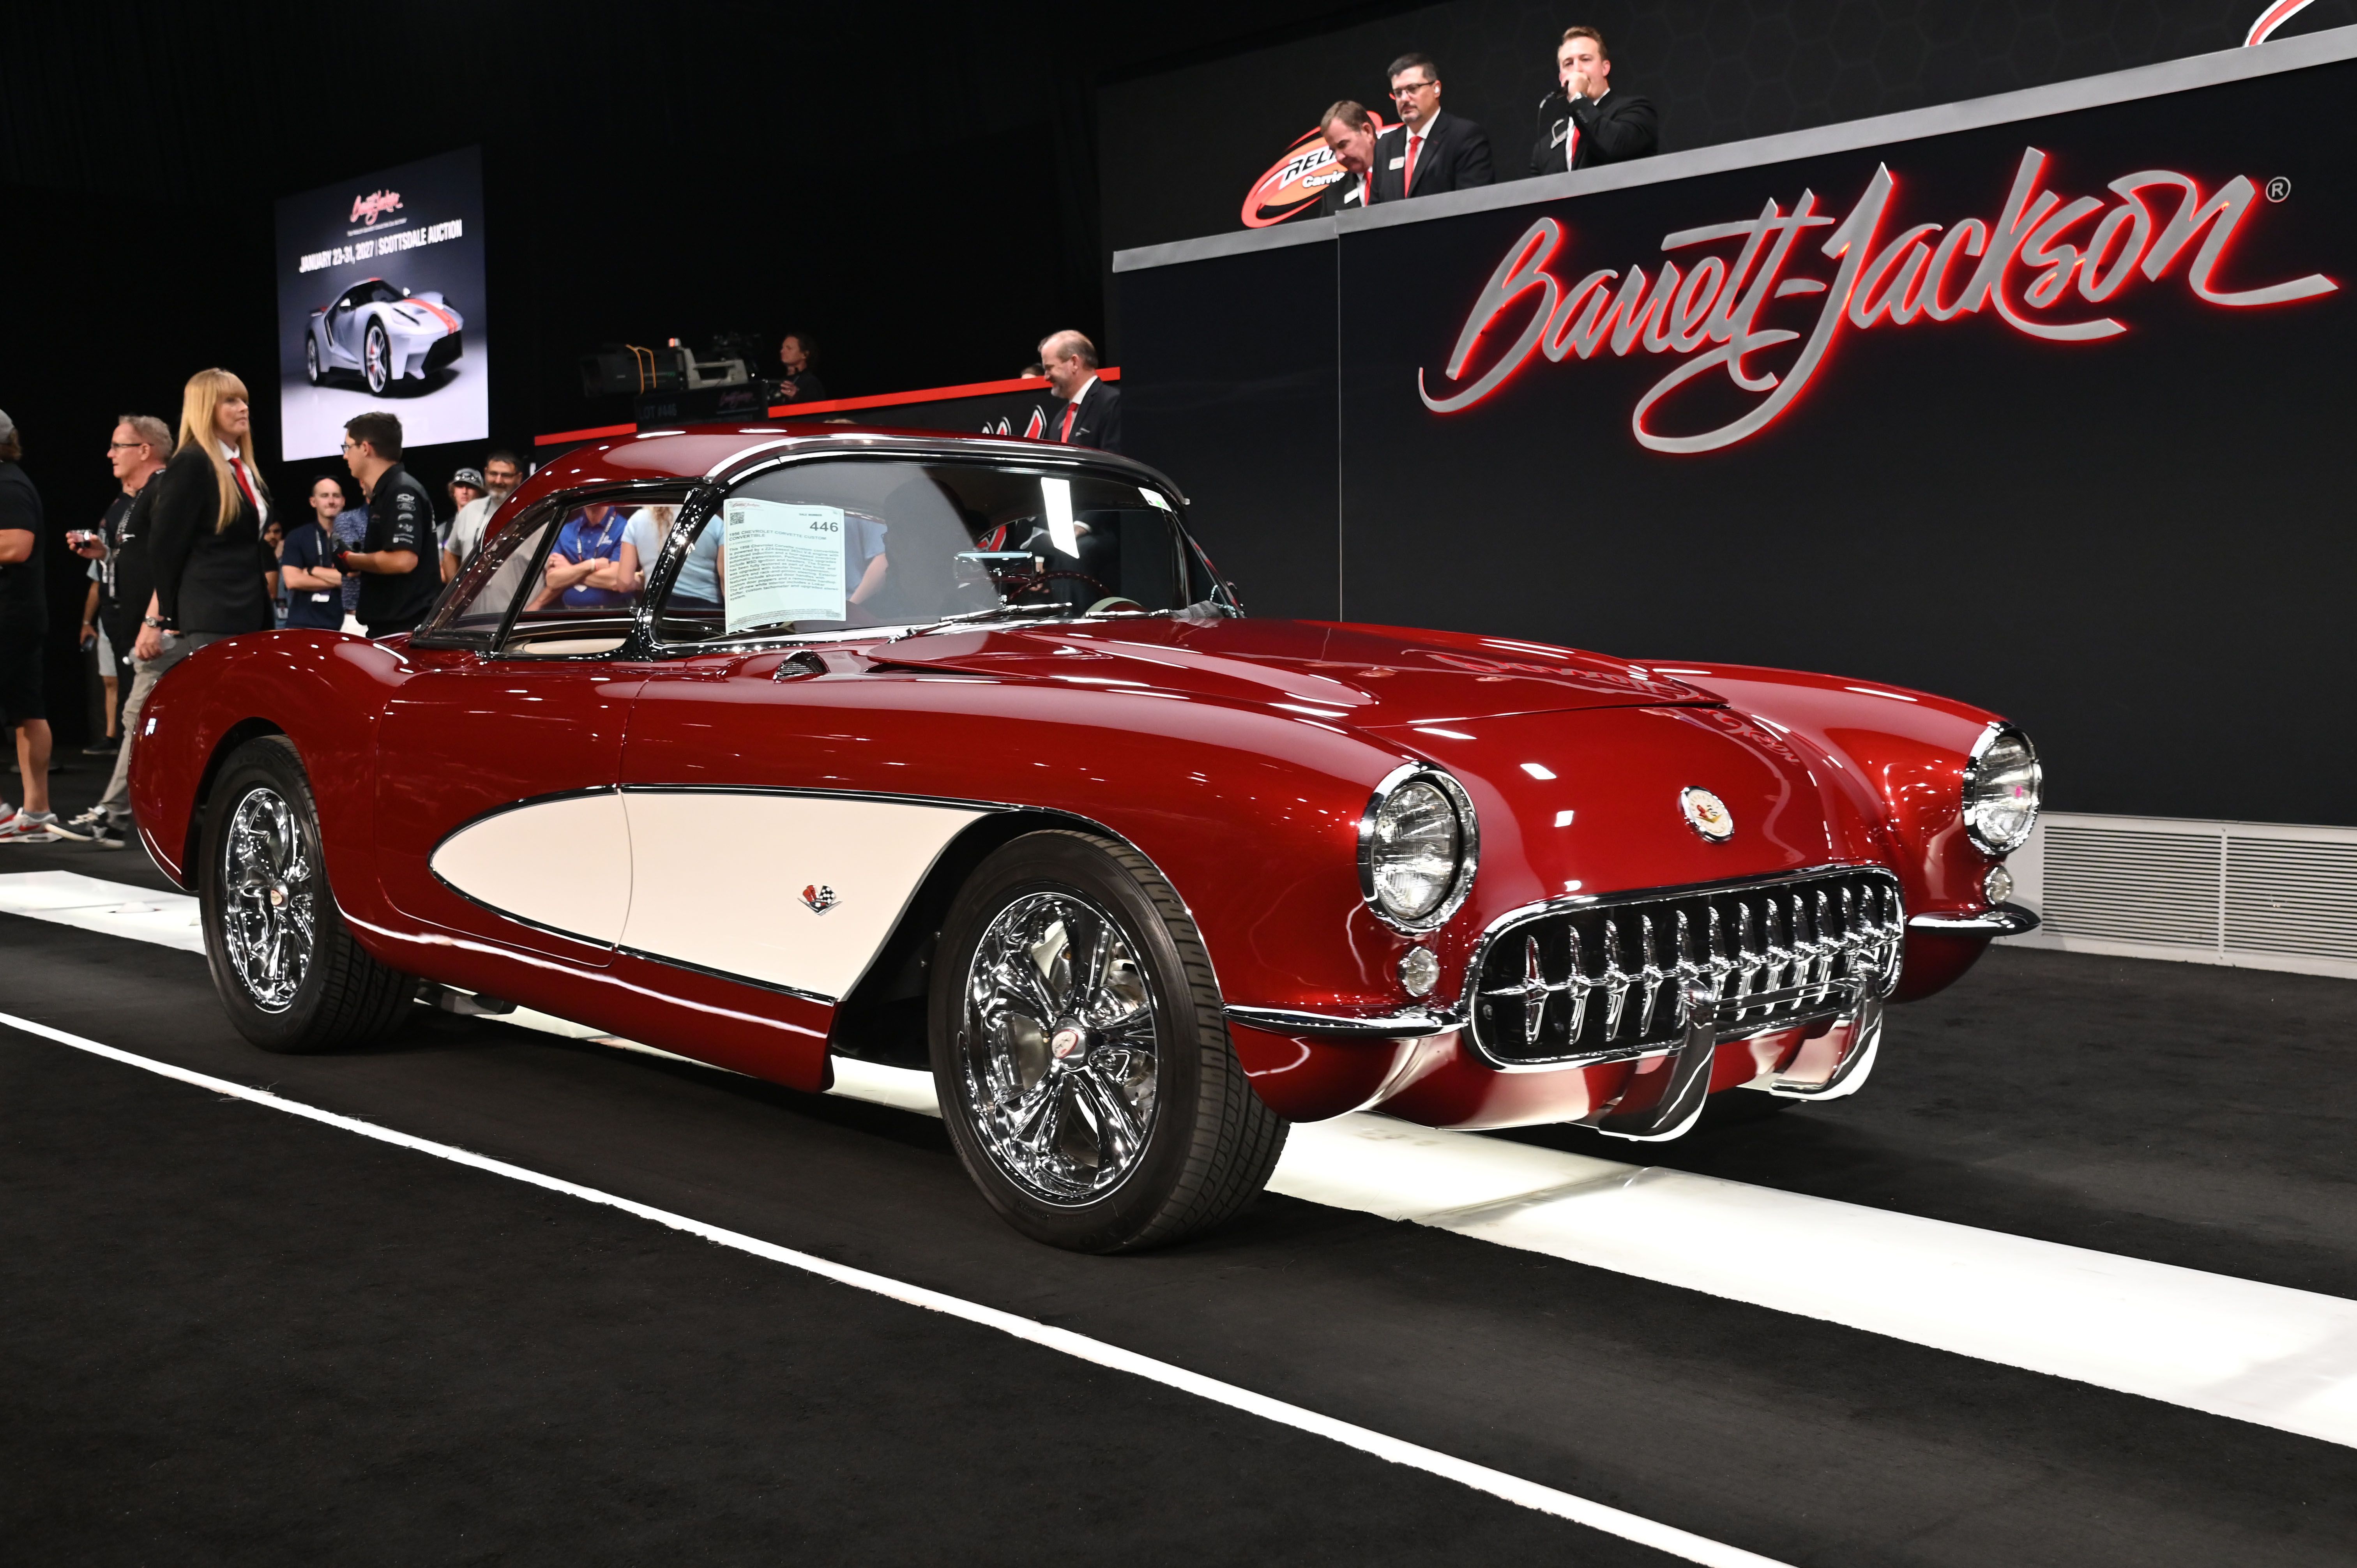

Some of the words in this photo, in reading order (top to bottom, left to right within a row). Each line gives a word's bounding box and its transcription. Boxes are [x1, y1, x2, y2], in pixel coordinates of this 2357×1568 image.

[299, 249, 332, 273] JANUARY
[355, 240, 375, 261] 2027
[378, 227, 427, 255] SCOTTSDALE
[427, 219, 463, 244] AUCTION
[1417, 145, 2339, 454] Barrett-Jackson
[809, 521, 839, 532] 446
